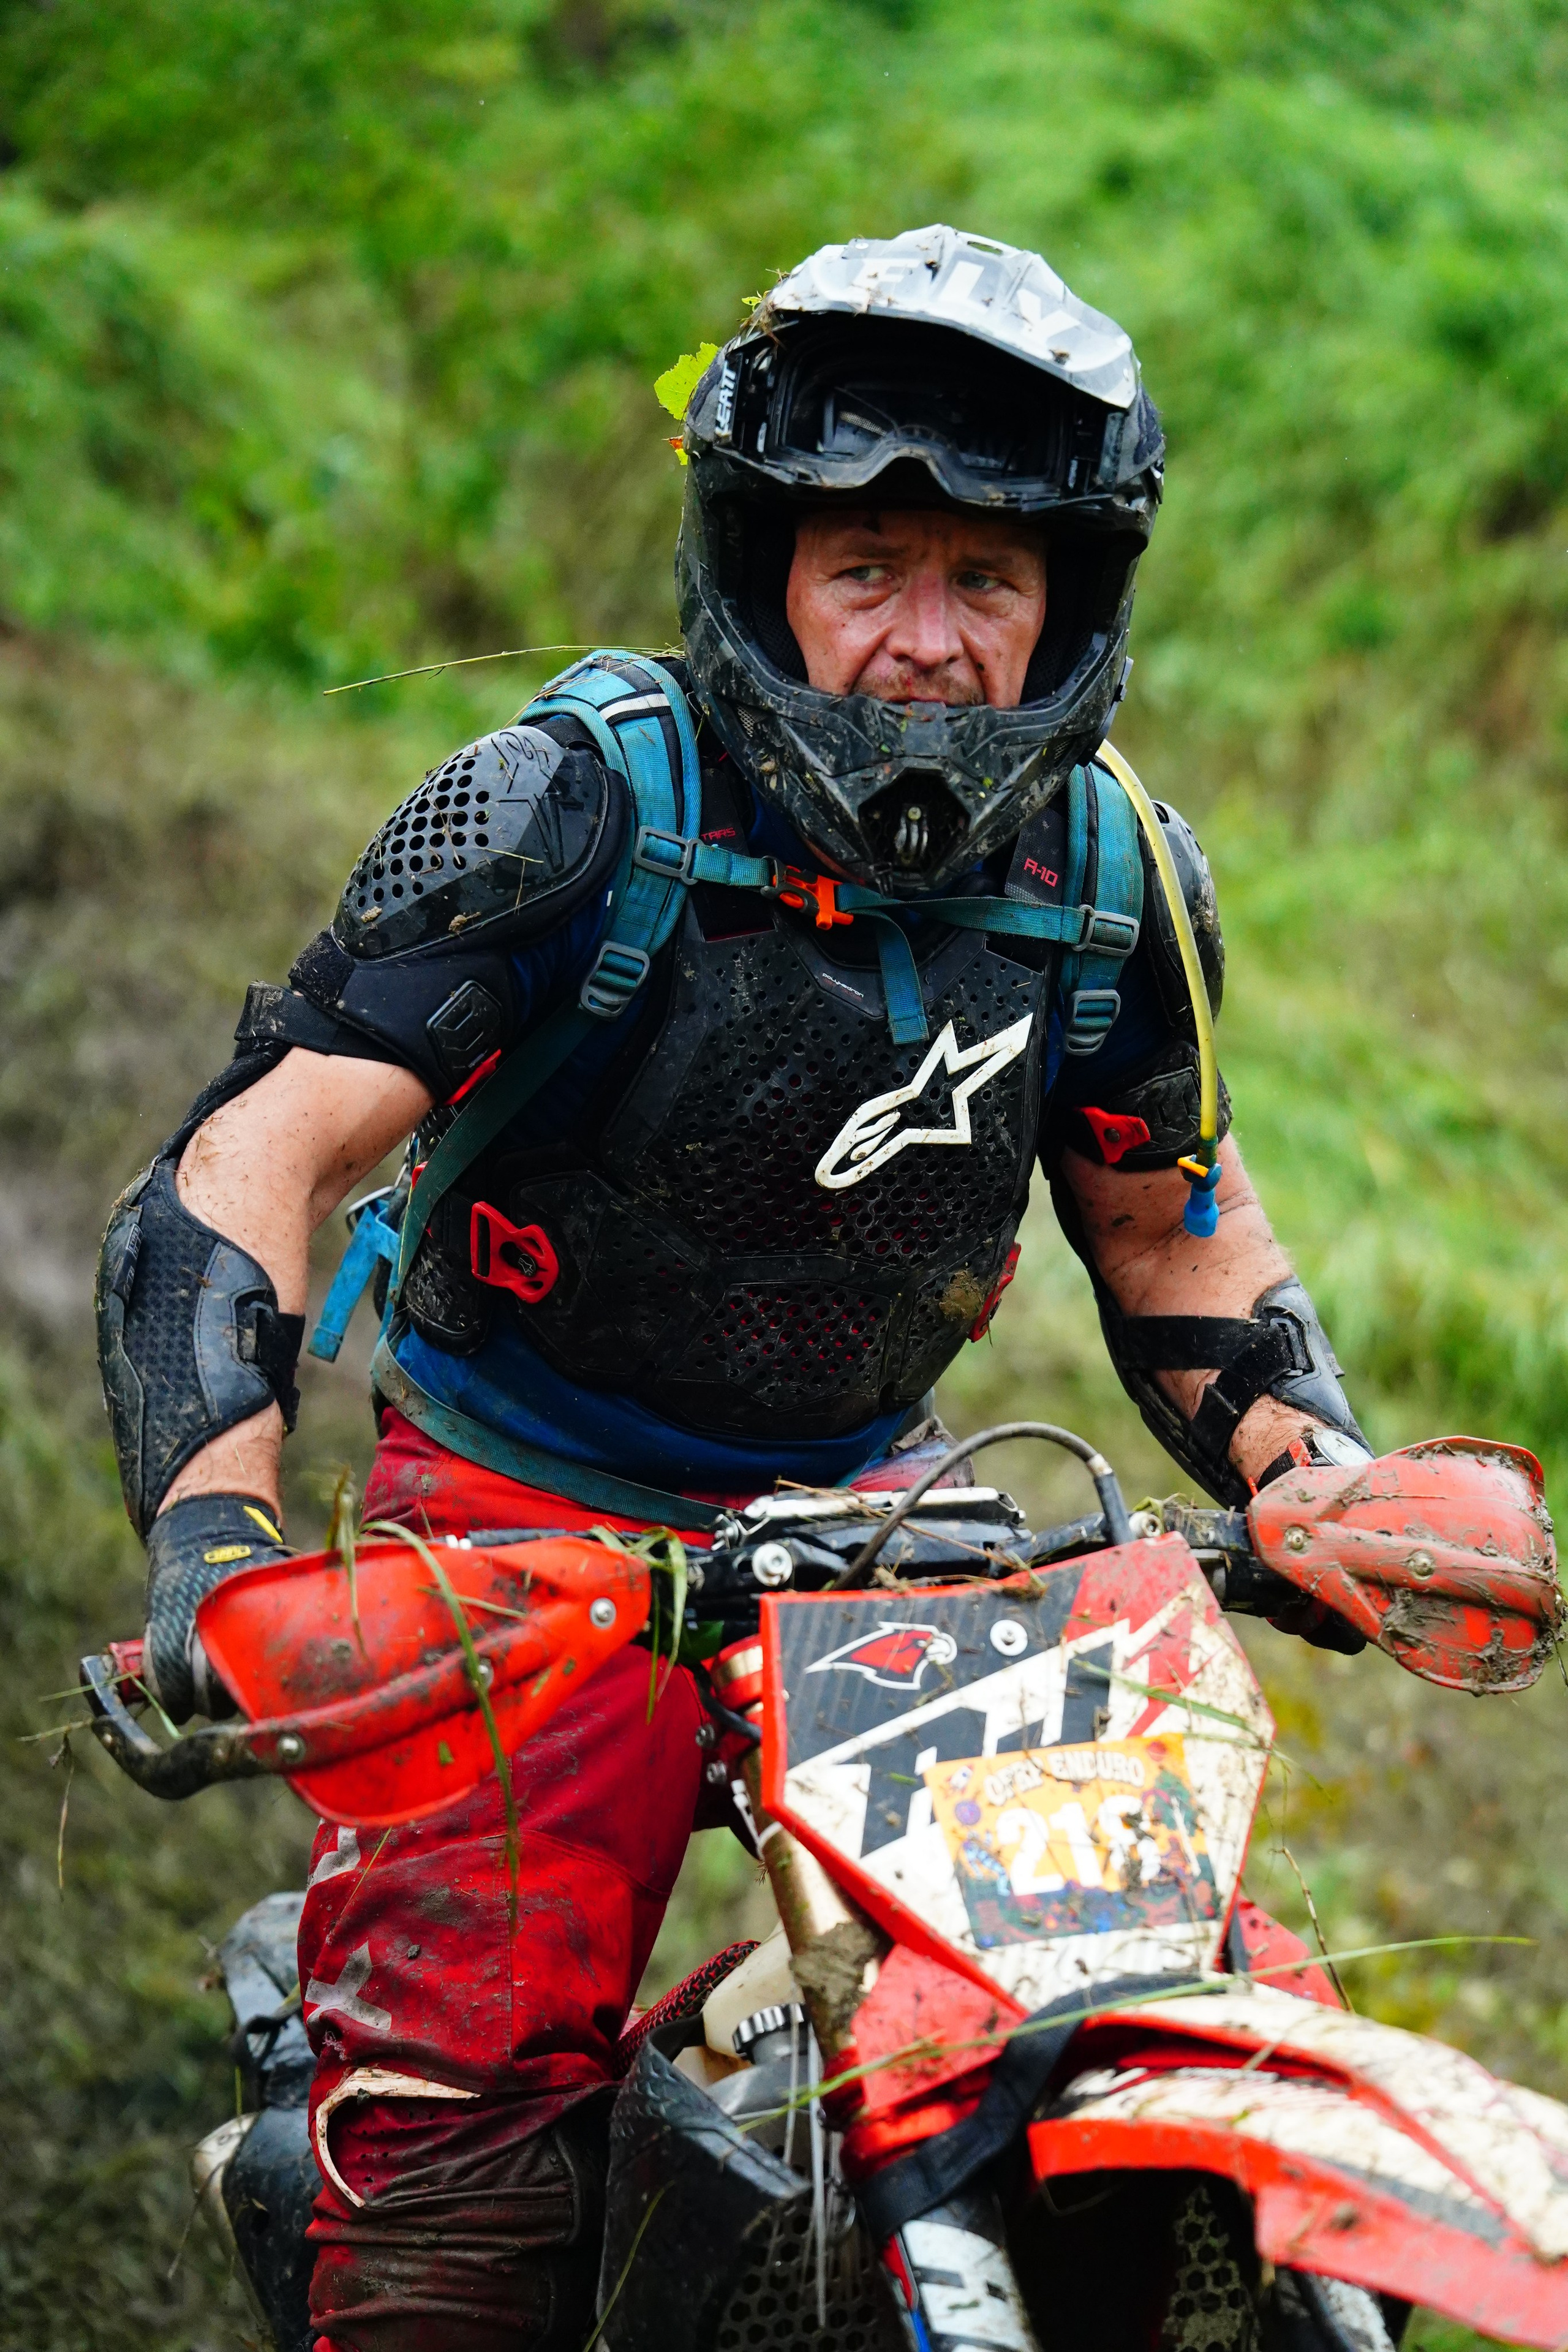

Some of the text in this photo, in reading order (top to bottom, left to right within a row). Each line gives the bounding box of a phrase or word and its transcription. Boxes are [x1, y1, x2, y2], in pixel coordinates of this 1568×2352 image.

[850, 257, 1082, 344] FLY
[715, 360, 737, 437] LEATT
[1023, 858, 1058, 887] A-10
[1047, 1750, 1145, 1787] ENDURO
